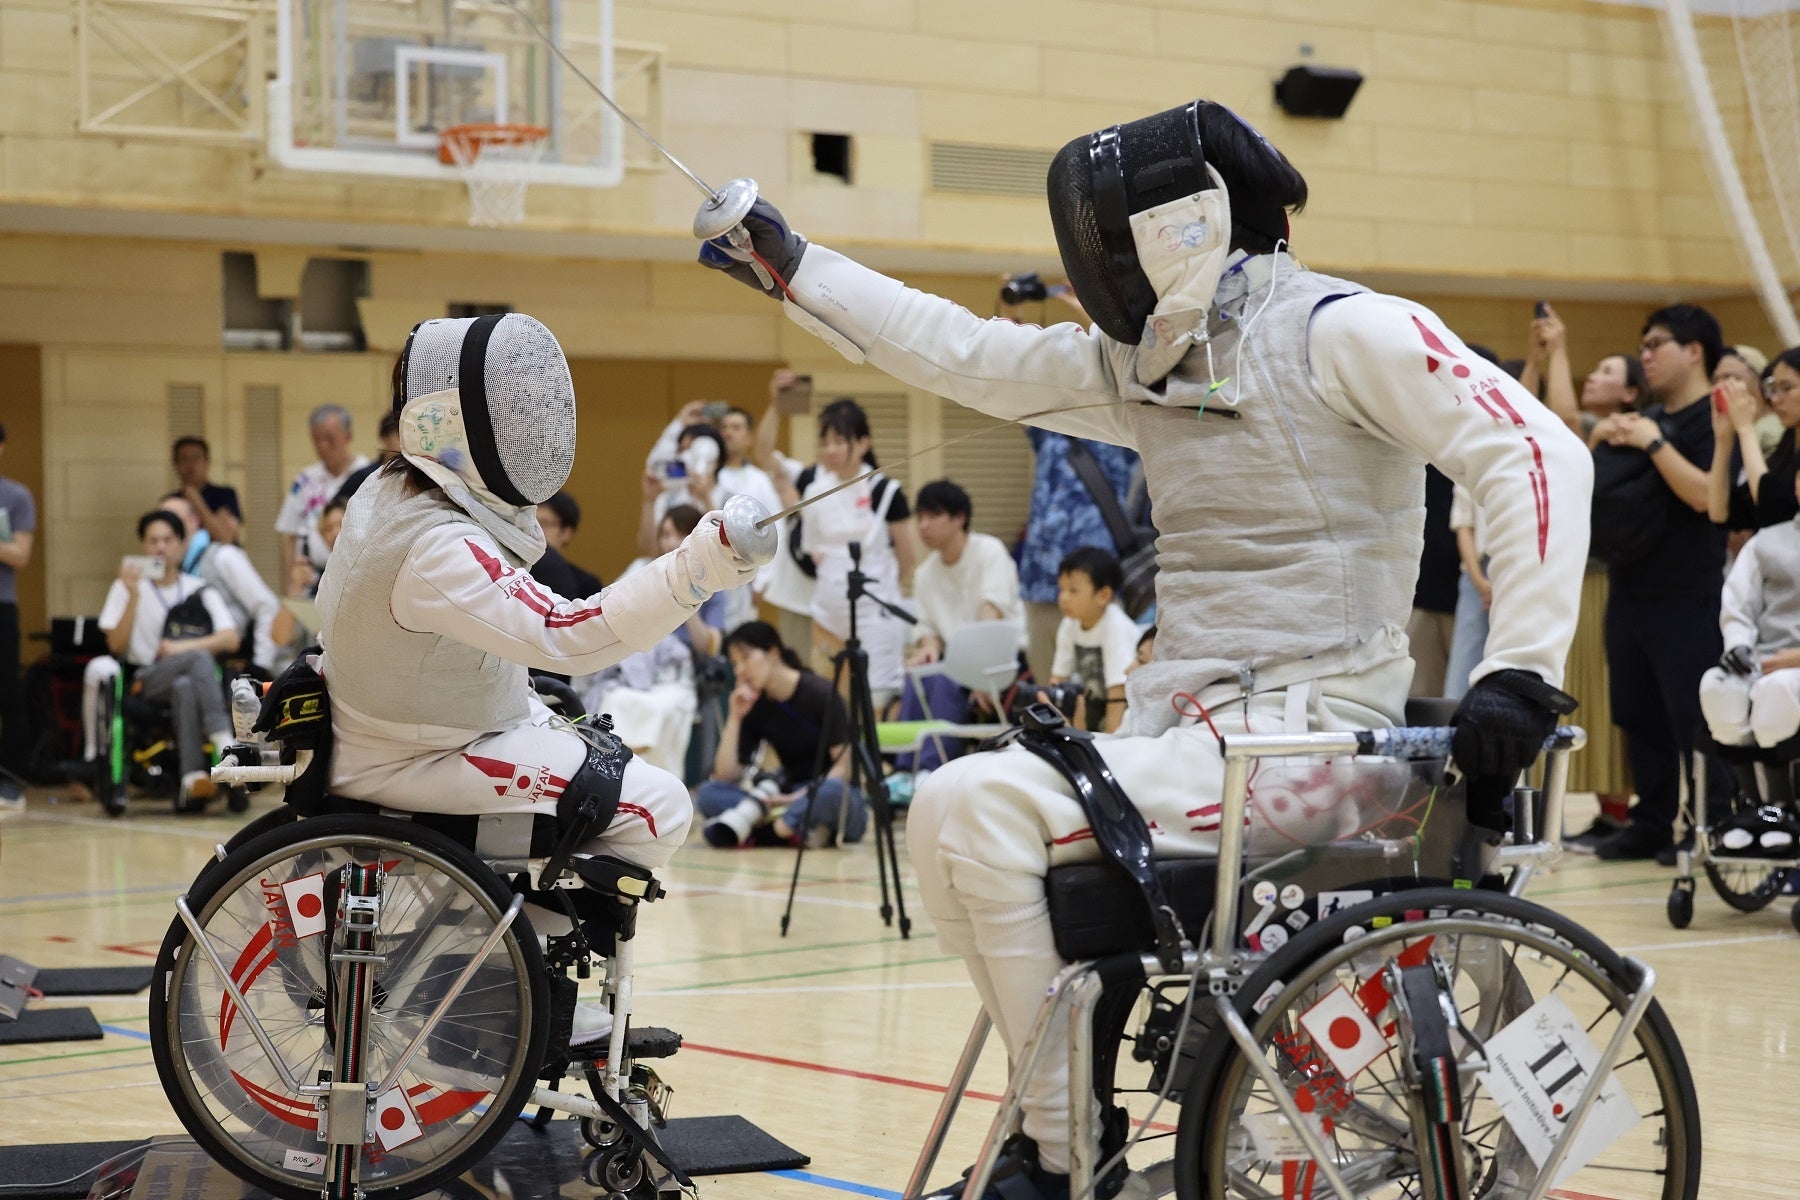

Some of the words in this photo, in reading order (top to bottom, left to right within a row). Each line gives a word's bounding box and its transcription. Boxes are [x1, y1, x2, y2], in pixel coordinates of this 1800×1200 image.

[503, 574, 532, 600] JAPA
[528, 765, 551, 804] JAPAN
[259, 878, 298, 947] JAPAN
[1274, 1030, 1355, 1113] JAPAN
[1495, 1053, 1525, 1092] Internet
